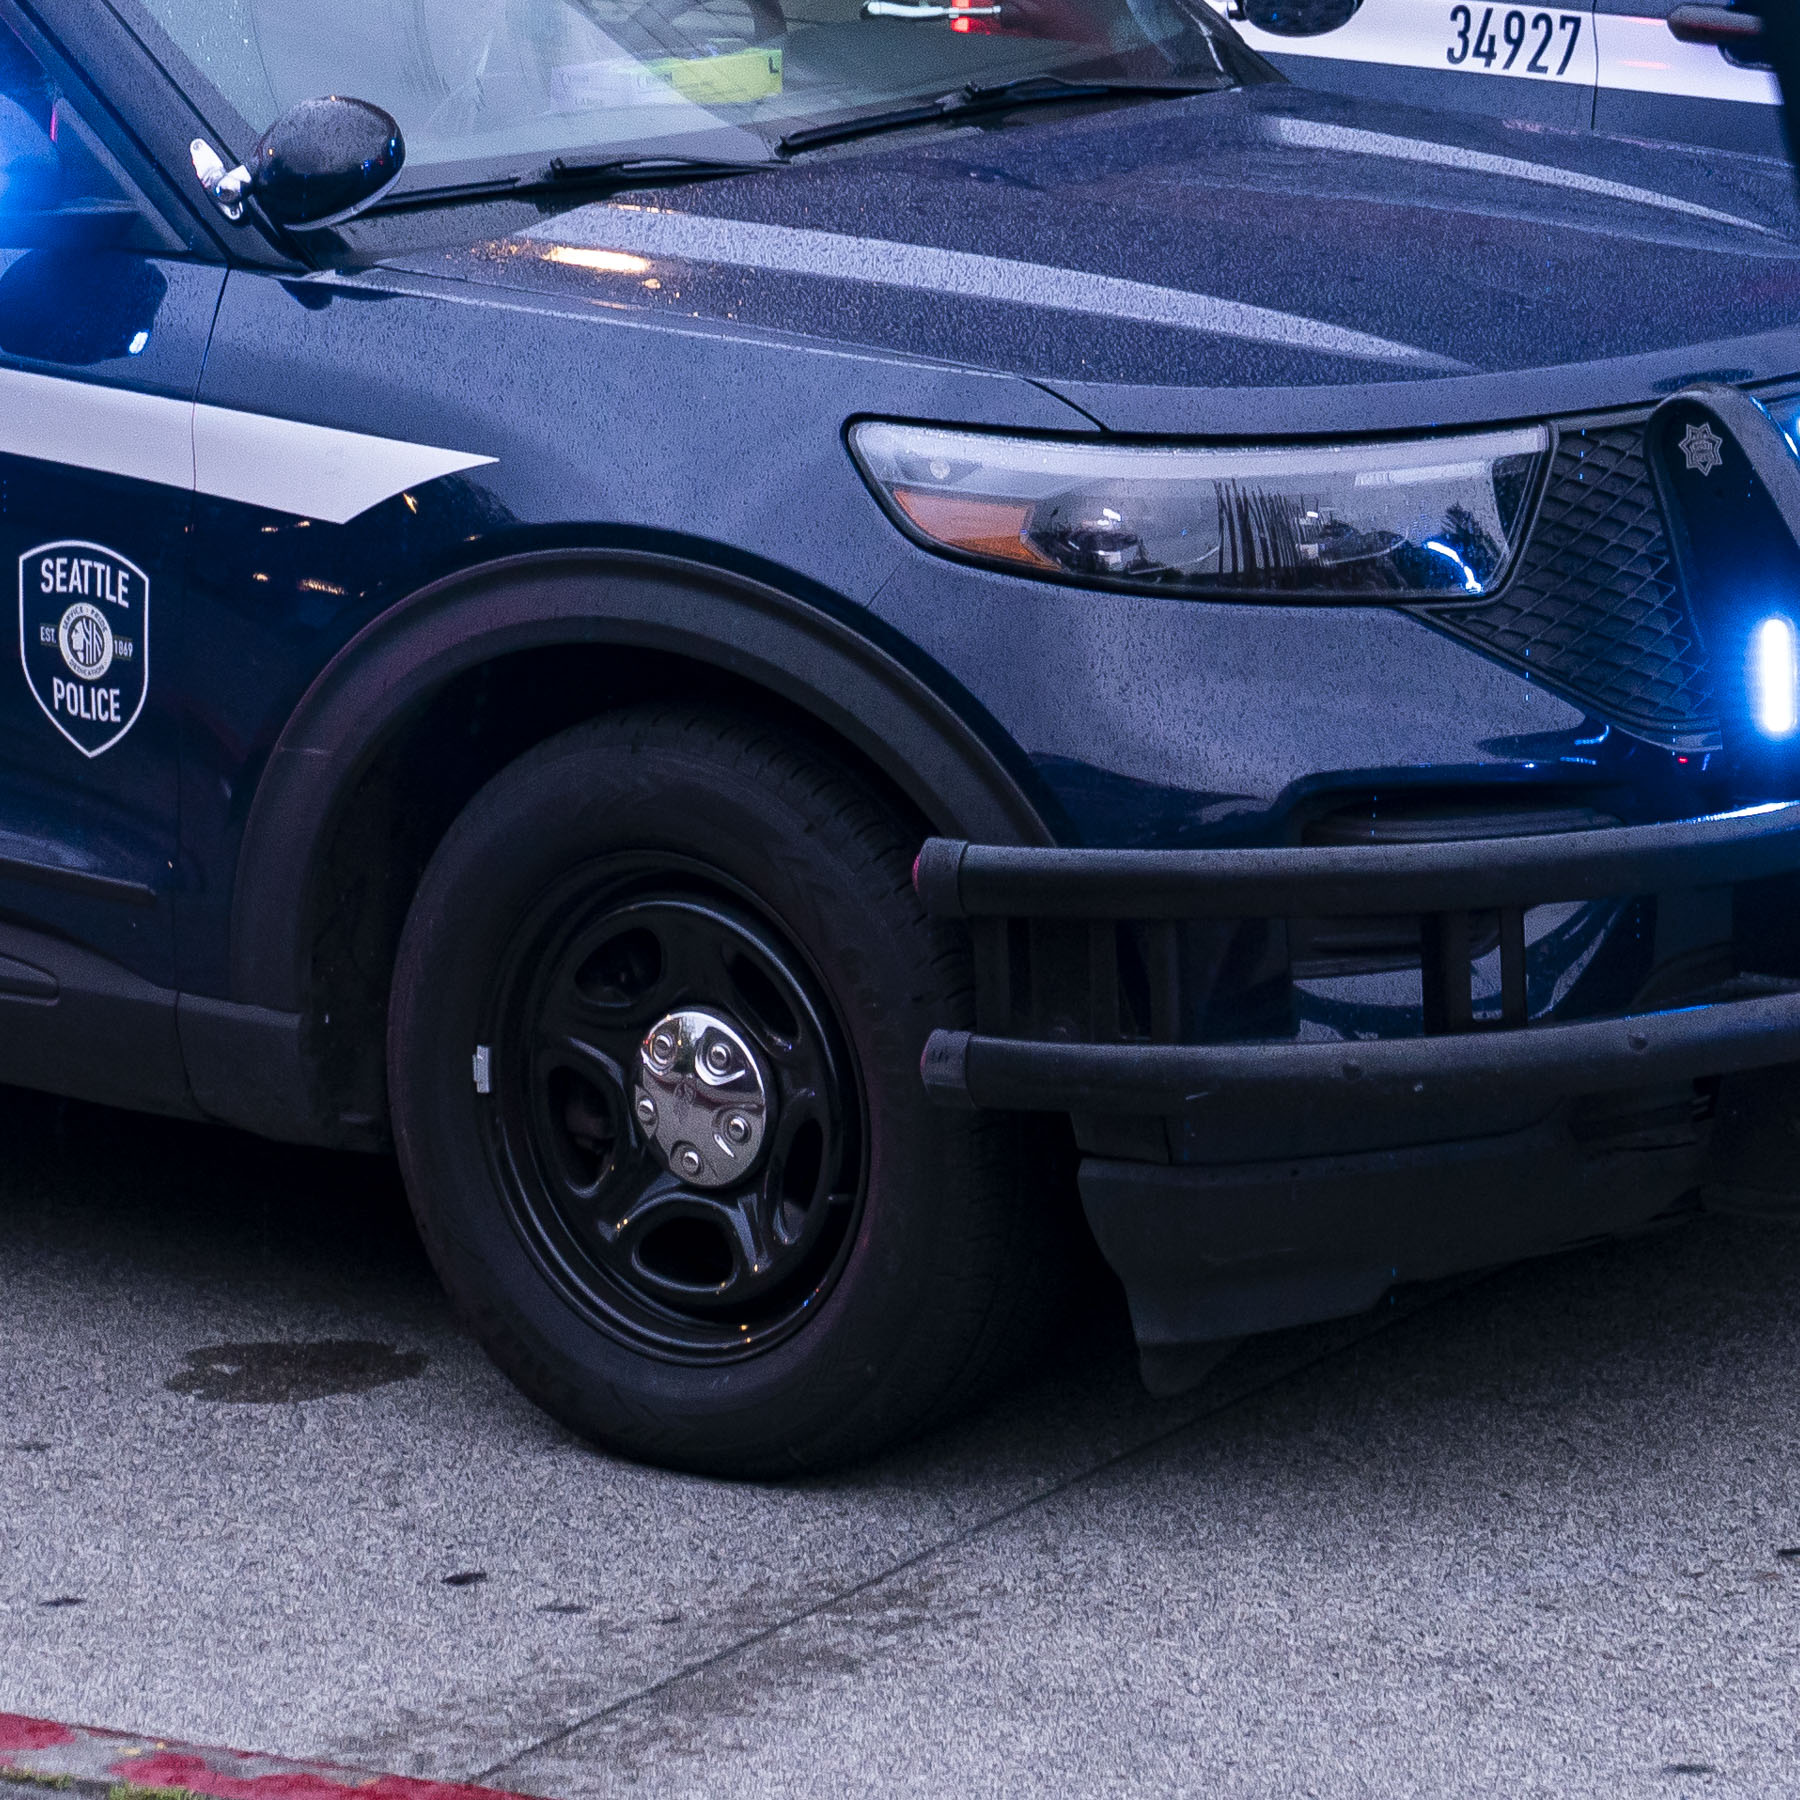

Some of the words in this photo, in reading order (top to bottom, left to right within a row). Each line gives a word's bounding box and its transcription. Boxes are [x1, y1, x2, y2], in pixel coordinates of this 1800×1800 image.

[1446, 4, 1582, 77] 34927
[40, 557, 130, 608] SEATTLE
[40, 626, 57, 644] EST.
[114, 639, 133, 658] 1869
[52, 676, 121, 723] POLICE
